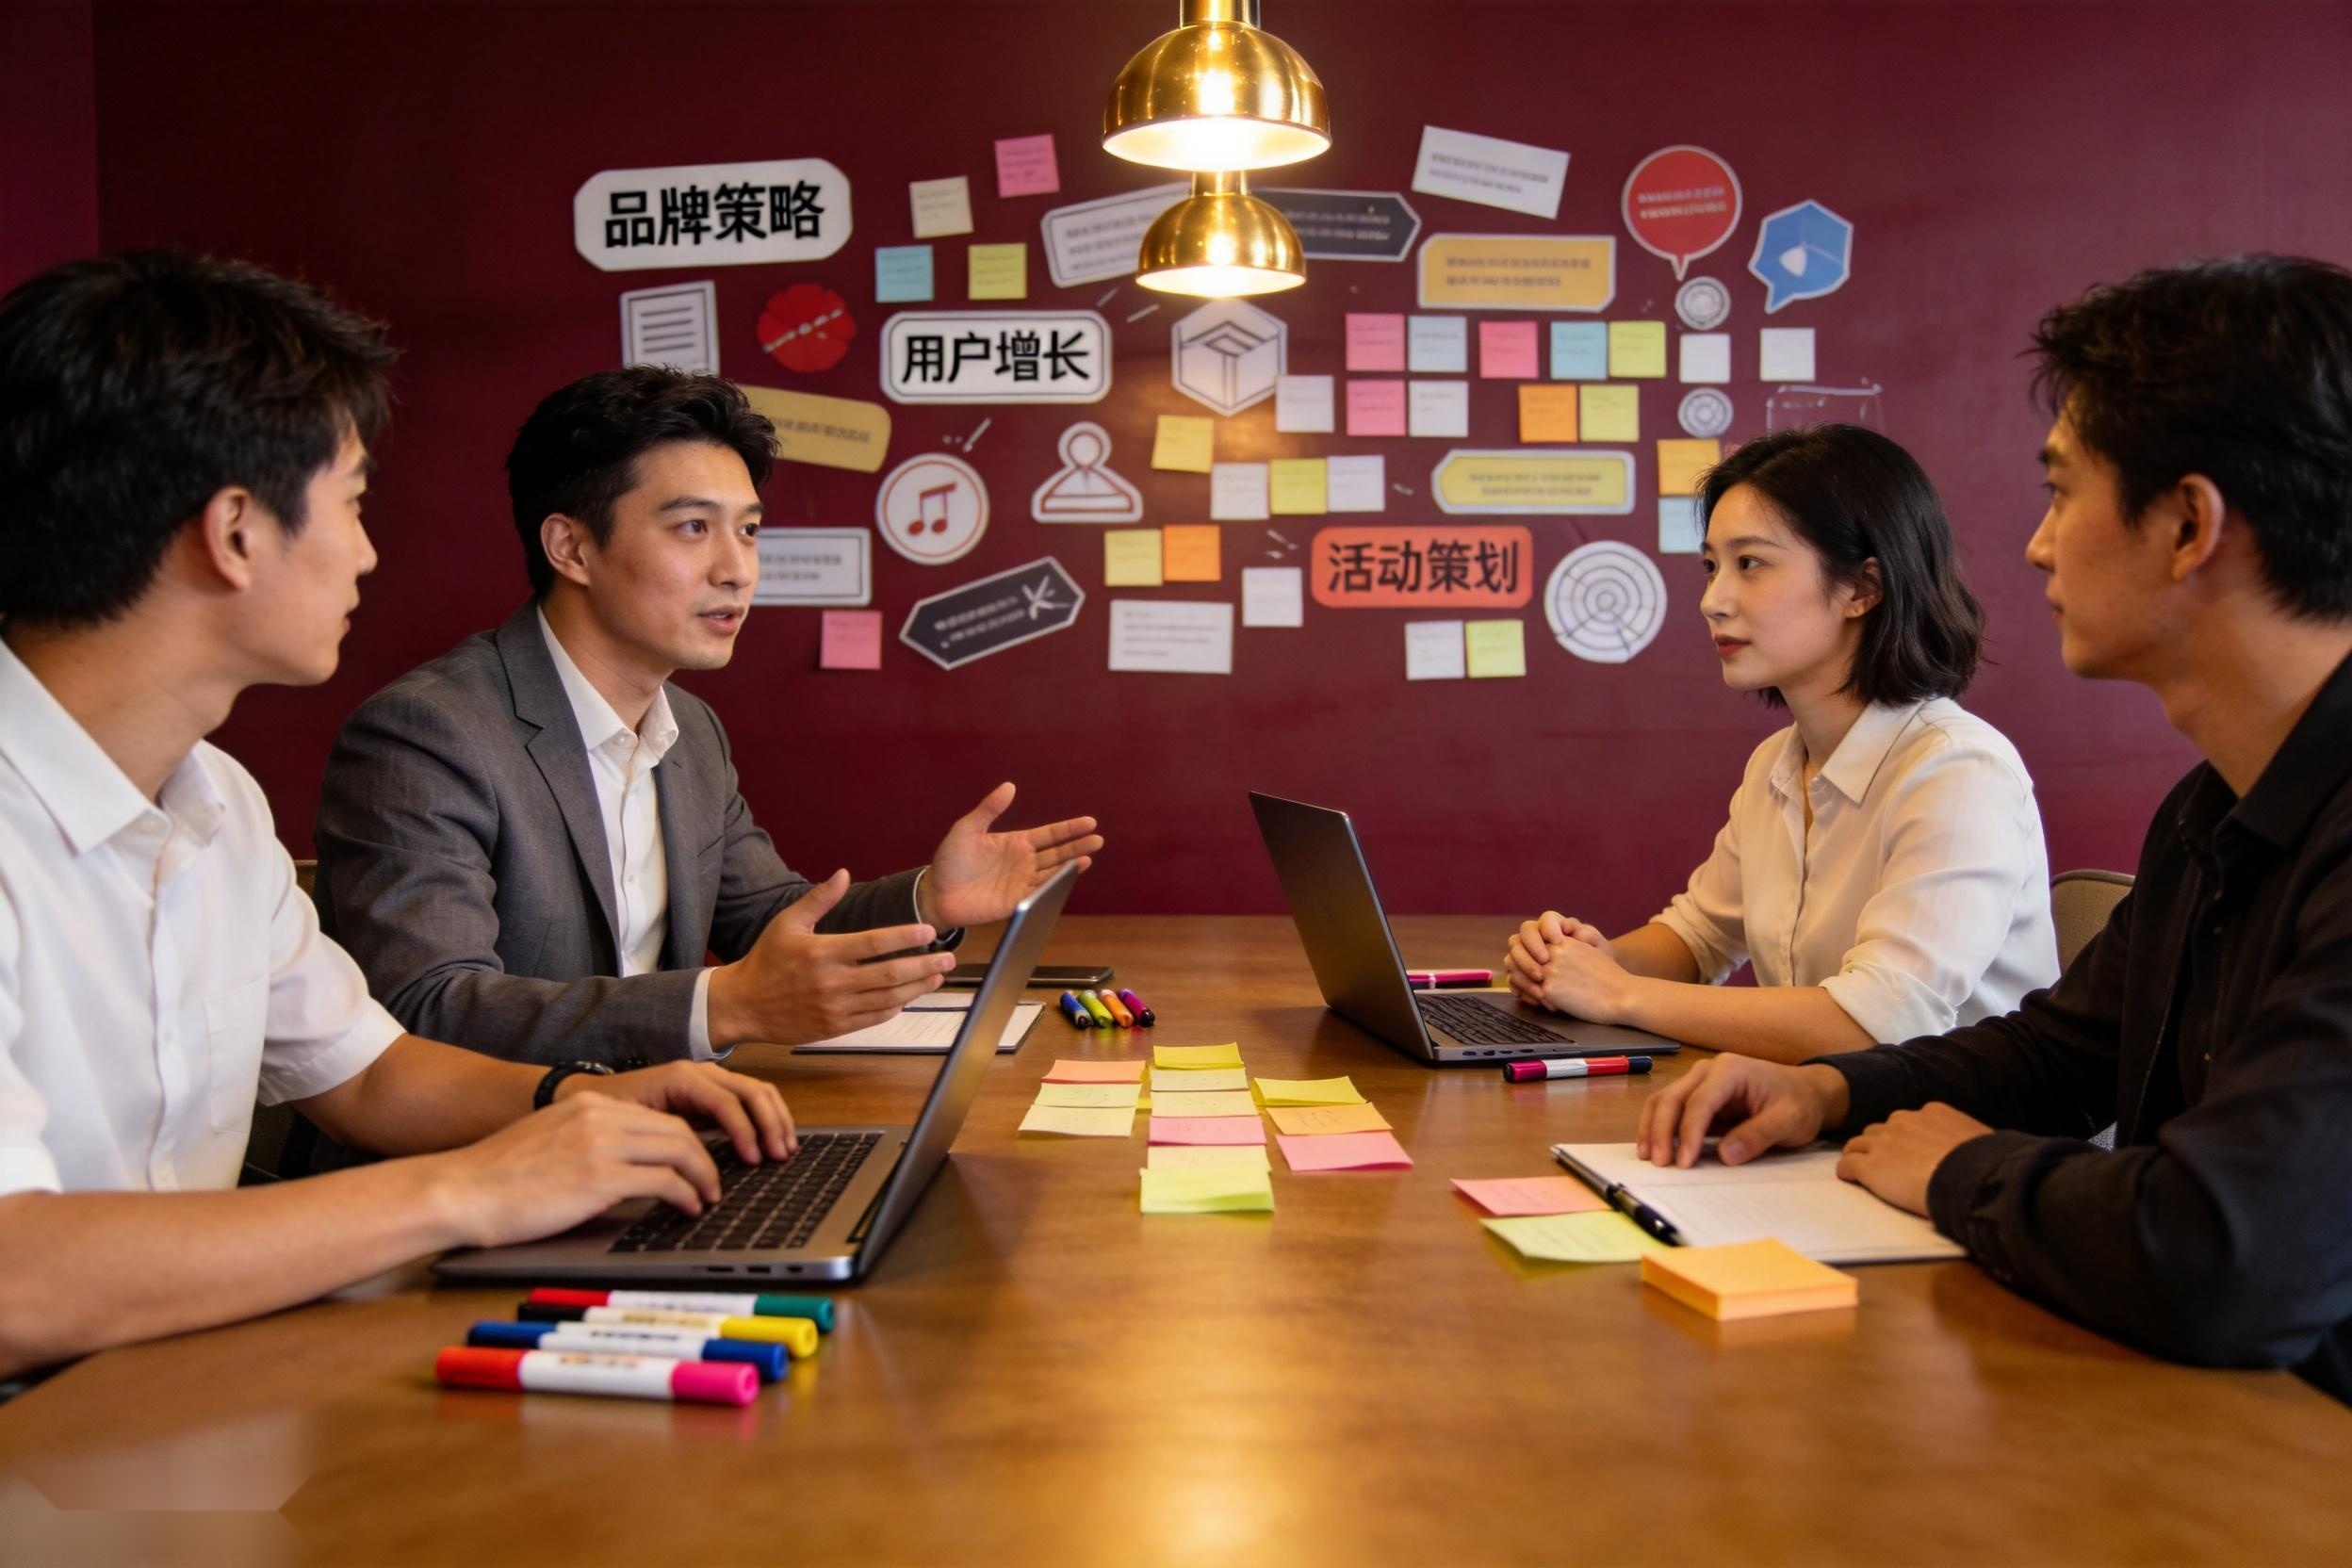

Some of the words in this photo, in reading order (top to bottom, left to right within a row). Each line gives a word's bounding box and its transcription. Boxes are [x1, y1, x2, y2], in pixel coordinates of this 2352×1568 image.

[604, 179, 825, 249] 品牌策略
[902, 330, 1090, 384] 用户增长
[1327, 539, 1519, 596] 活动策划
